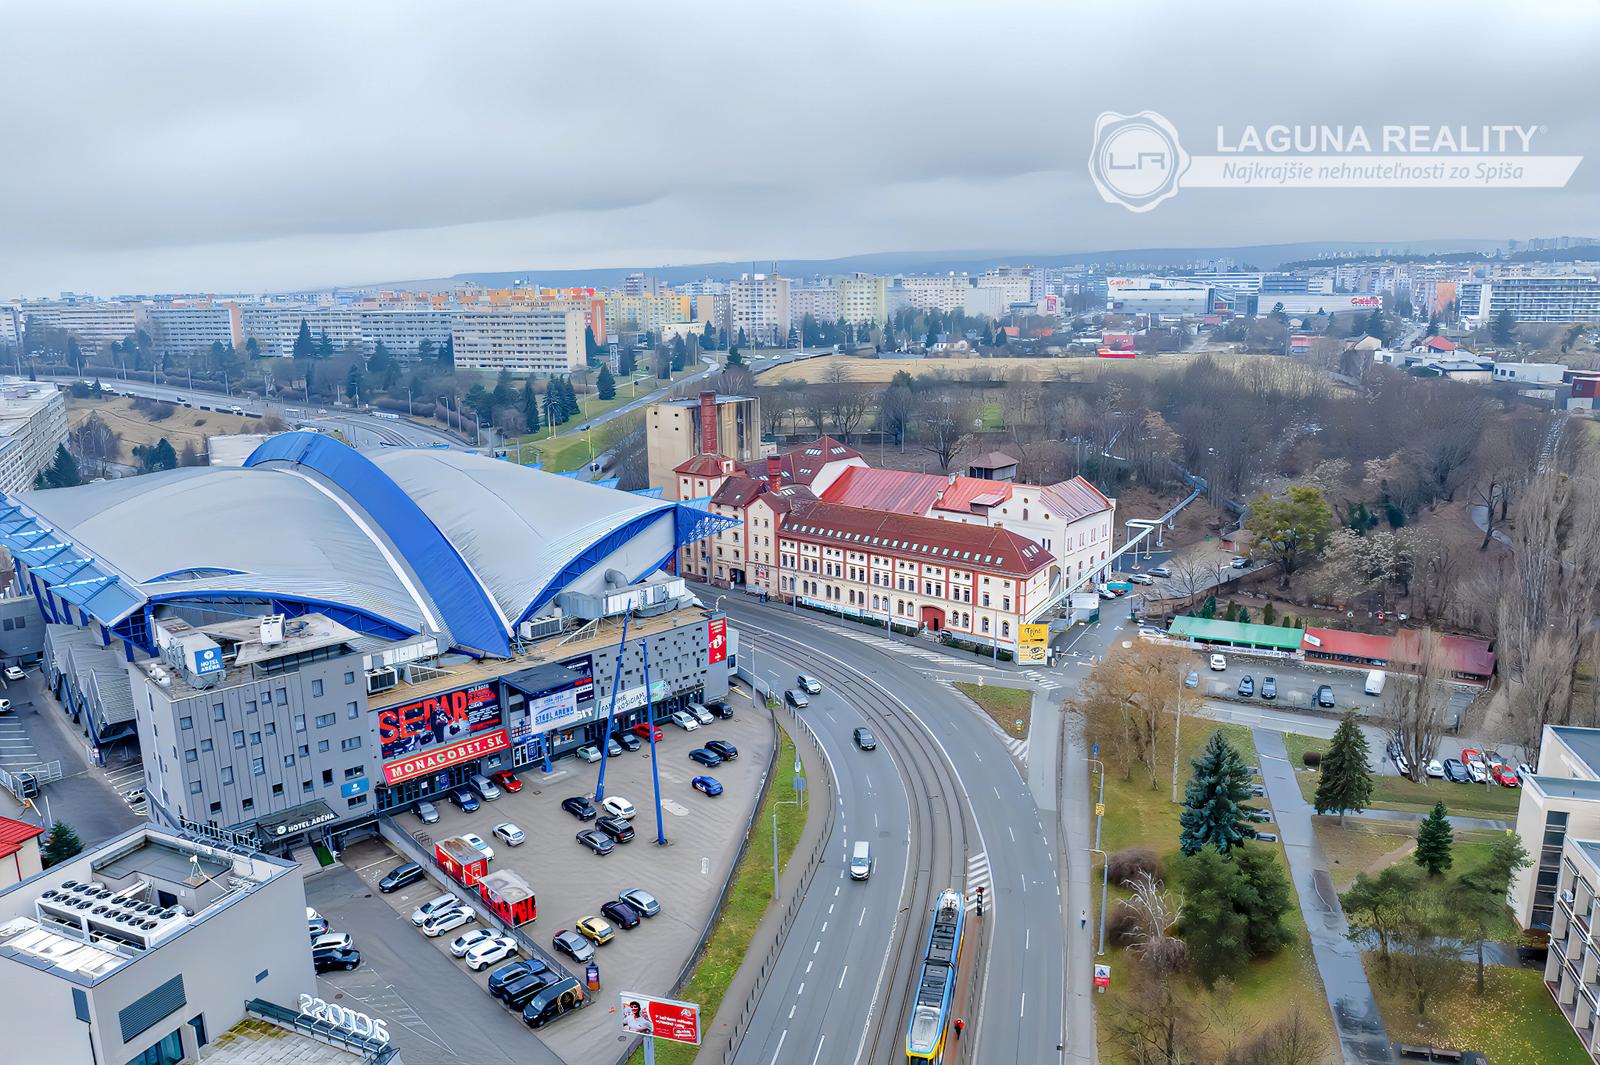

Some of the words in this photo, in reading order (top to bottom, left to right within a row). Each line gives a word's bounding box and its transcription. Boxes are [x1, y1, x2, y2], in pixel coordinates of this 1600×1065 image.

[534, 711, 554, 724] STEEL
[554, 705, 576, 717] ARENA
[391, 735, 504, 777] MONACOBET.SK
[288, 820, 310, 833] HOTEL
